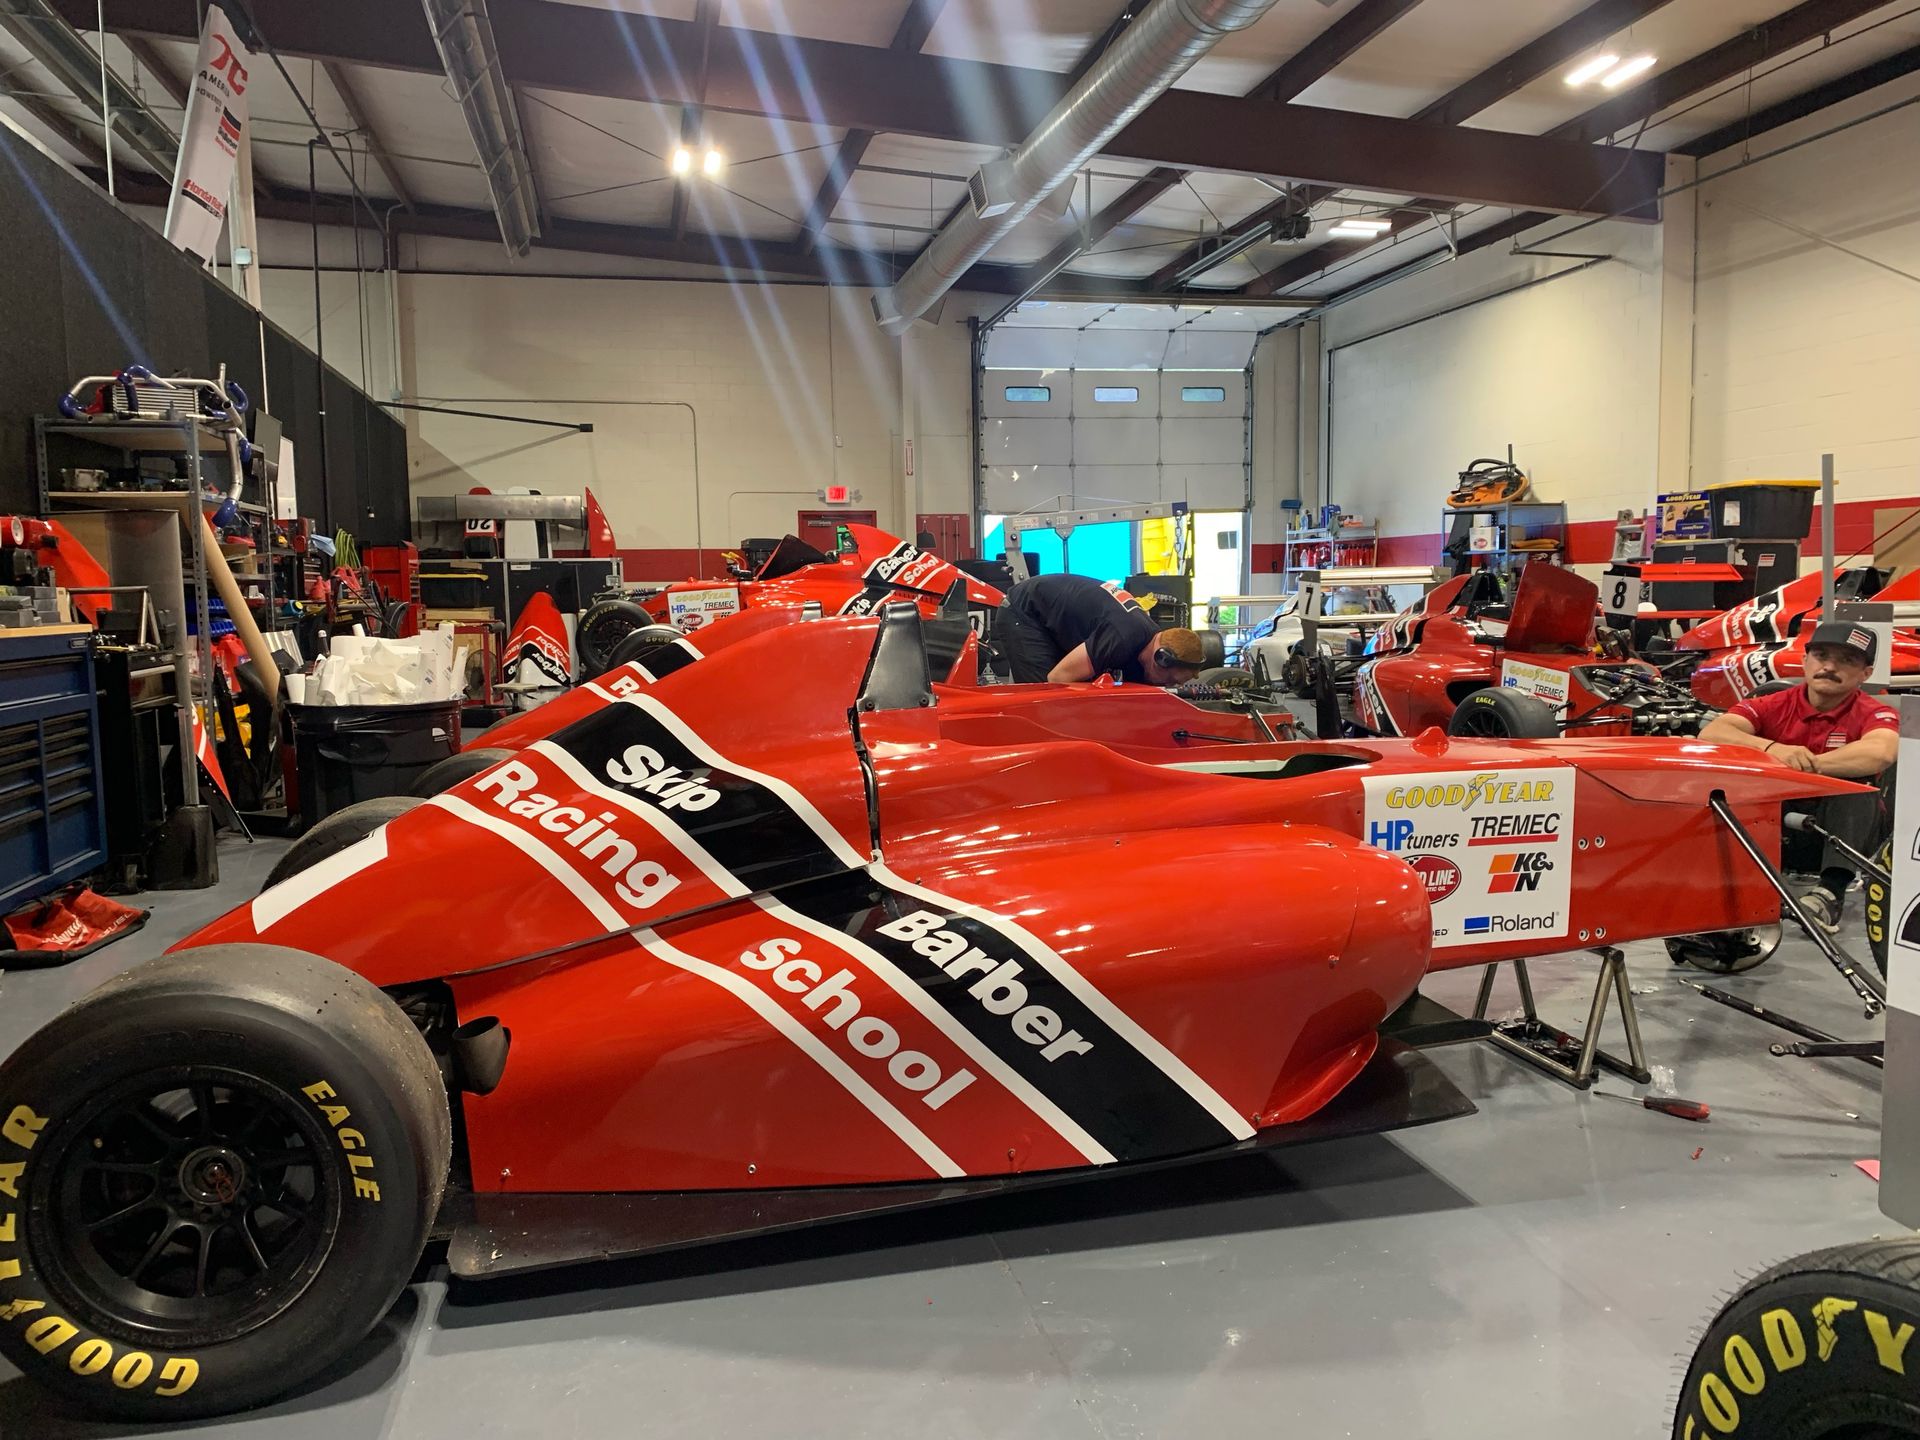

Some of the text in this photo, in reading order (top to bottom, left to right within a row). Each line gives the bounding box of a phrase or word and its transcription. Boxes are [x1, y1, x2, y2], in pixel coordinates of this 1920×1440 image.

[703, 600, 735, 610] TREMEC
[1305, 586, 1314, 615] 7
[1612, 581, 1627, 609] 8
[847, 599, 871, 617] kip
[1207, 606, 1219, 624] 22
[1475, 696, 1497, 706] EAGLE
[1534, 684, 1564, 698] TREMEC
[606, 744, 722, 812] Skip
[474, 760, 682, 910] Racing
[1470, 813, 1561, 838] TREMEC
[1428, 868, 1456, 887] LINE
[1491, 912, 1555, 932] Roland
[875, 910, 1094, 1063] Barber
[301, 1080, 381, 1202] EAGLE
